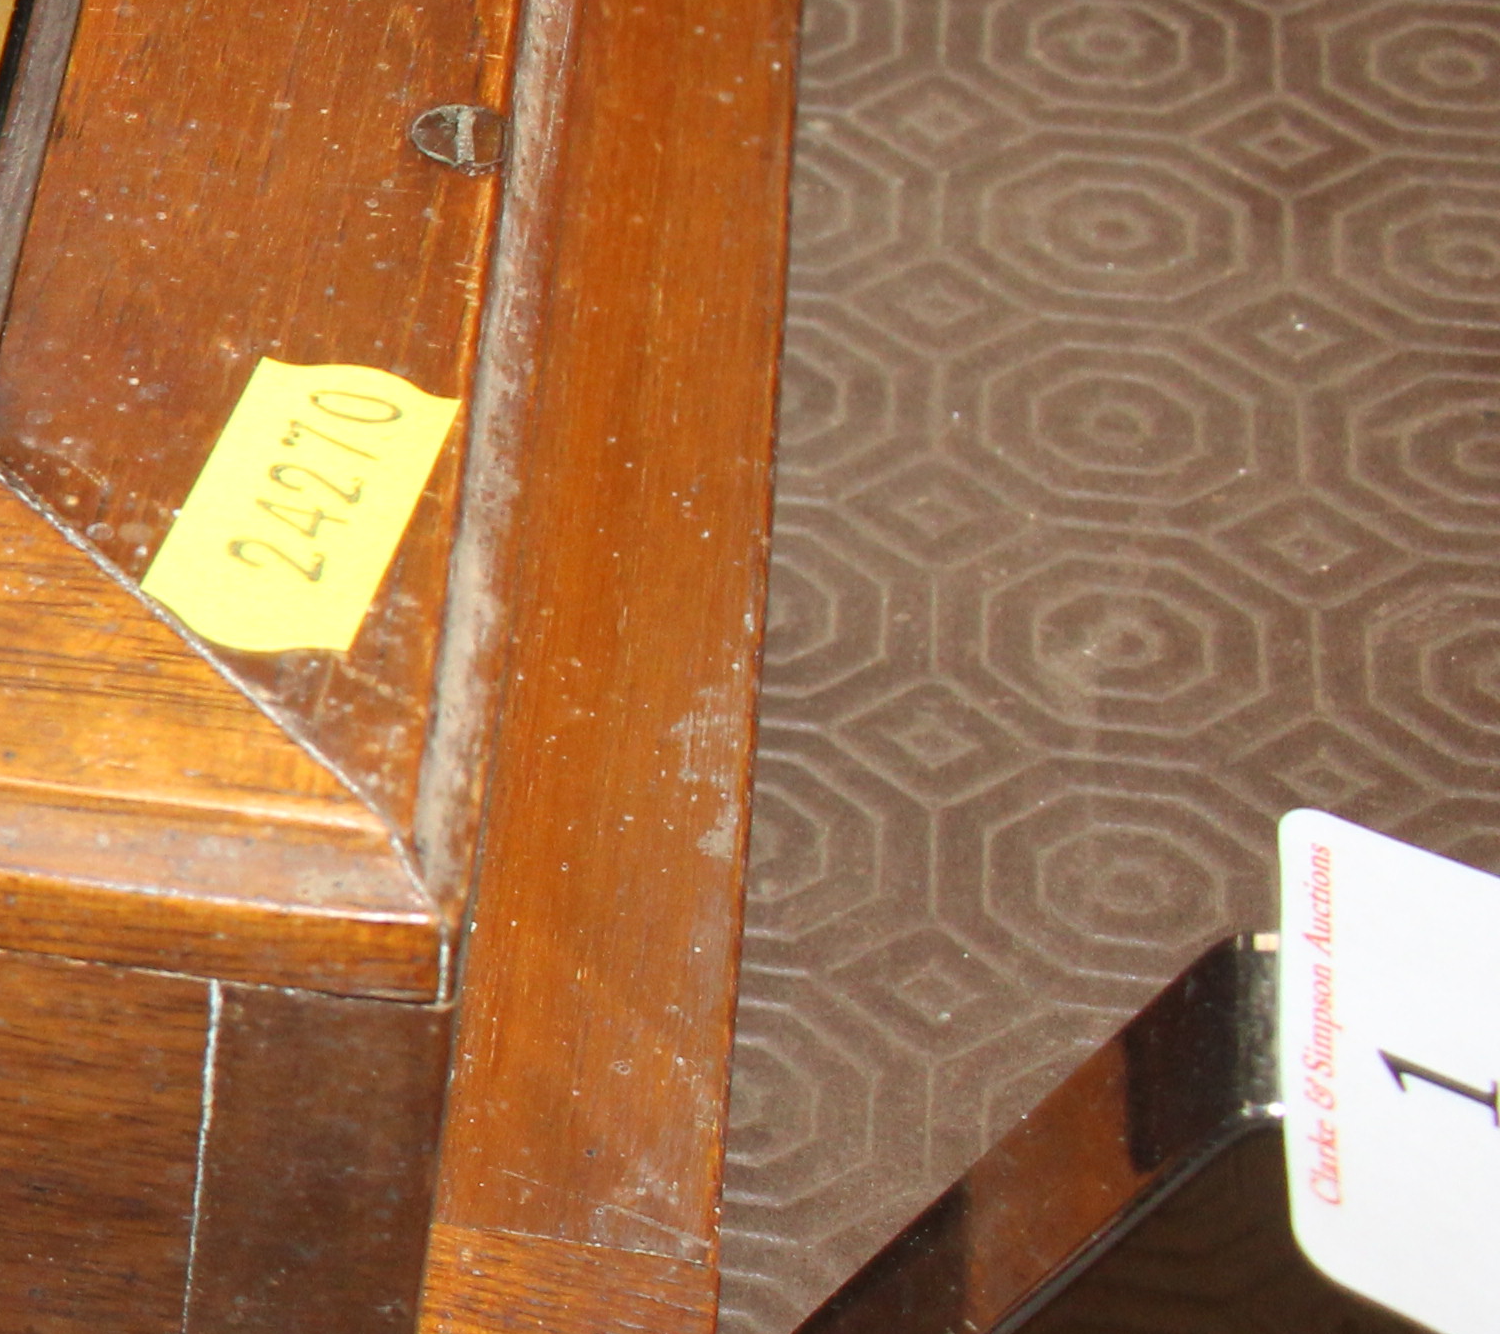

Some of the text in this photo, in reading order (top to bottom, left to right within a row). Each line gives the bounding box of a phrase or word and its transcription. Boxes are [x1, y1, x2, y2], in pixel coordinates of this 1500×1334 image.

[227, 390, 403, 582] 24270
[1301, 842, 1343, 1207] Clarke & Simpson Auctions
